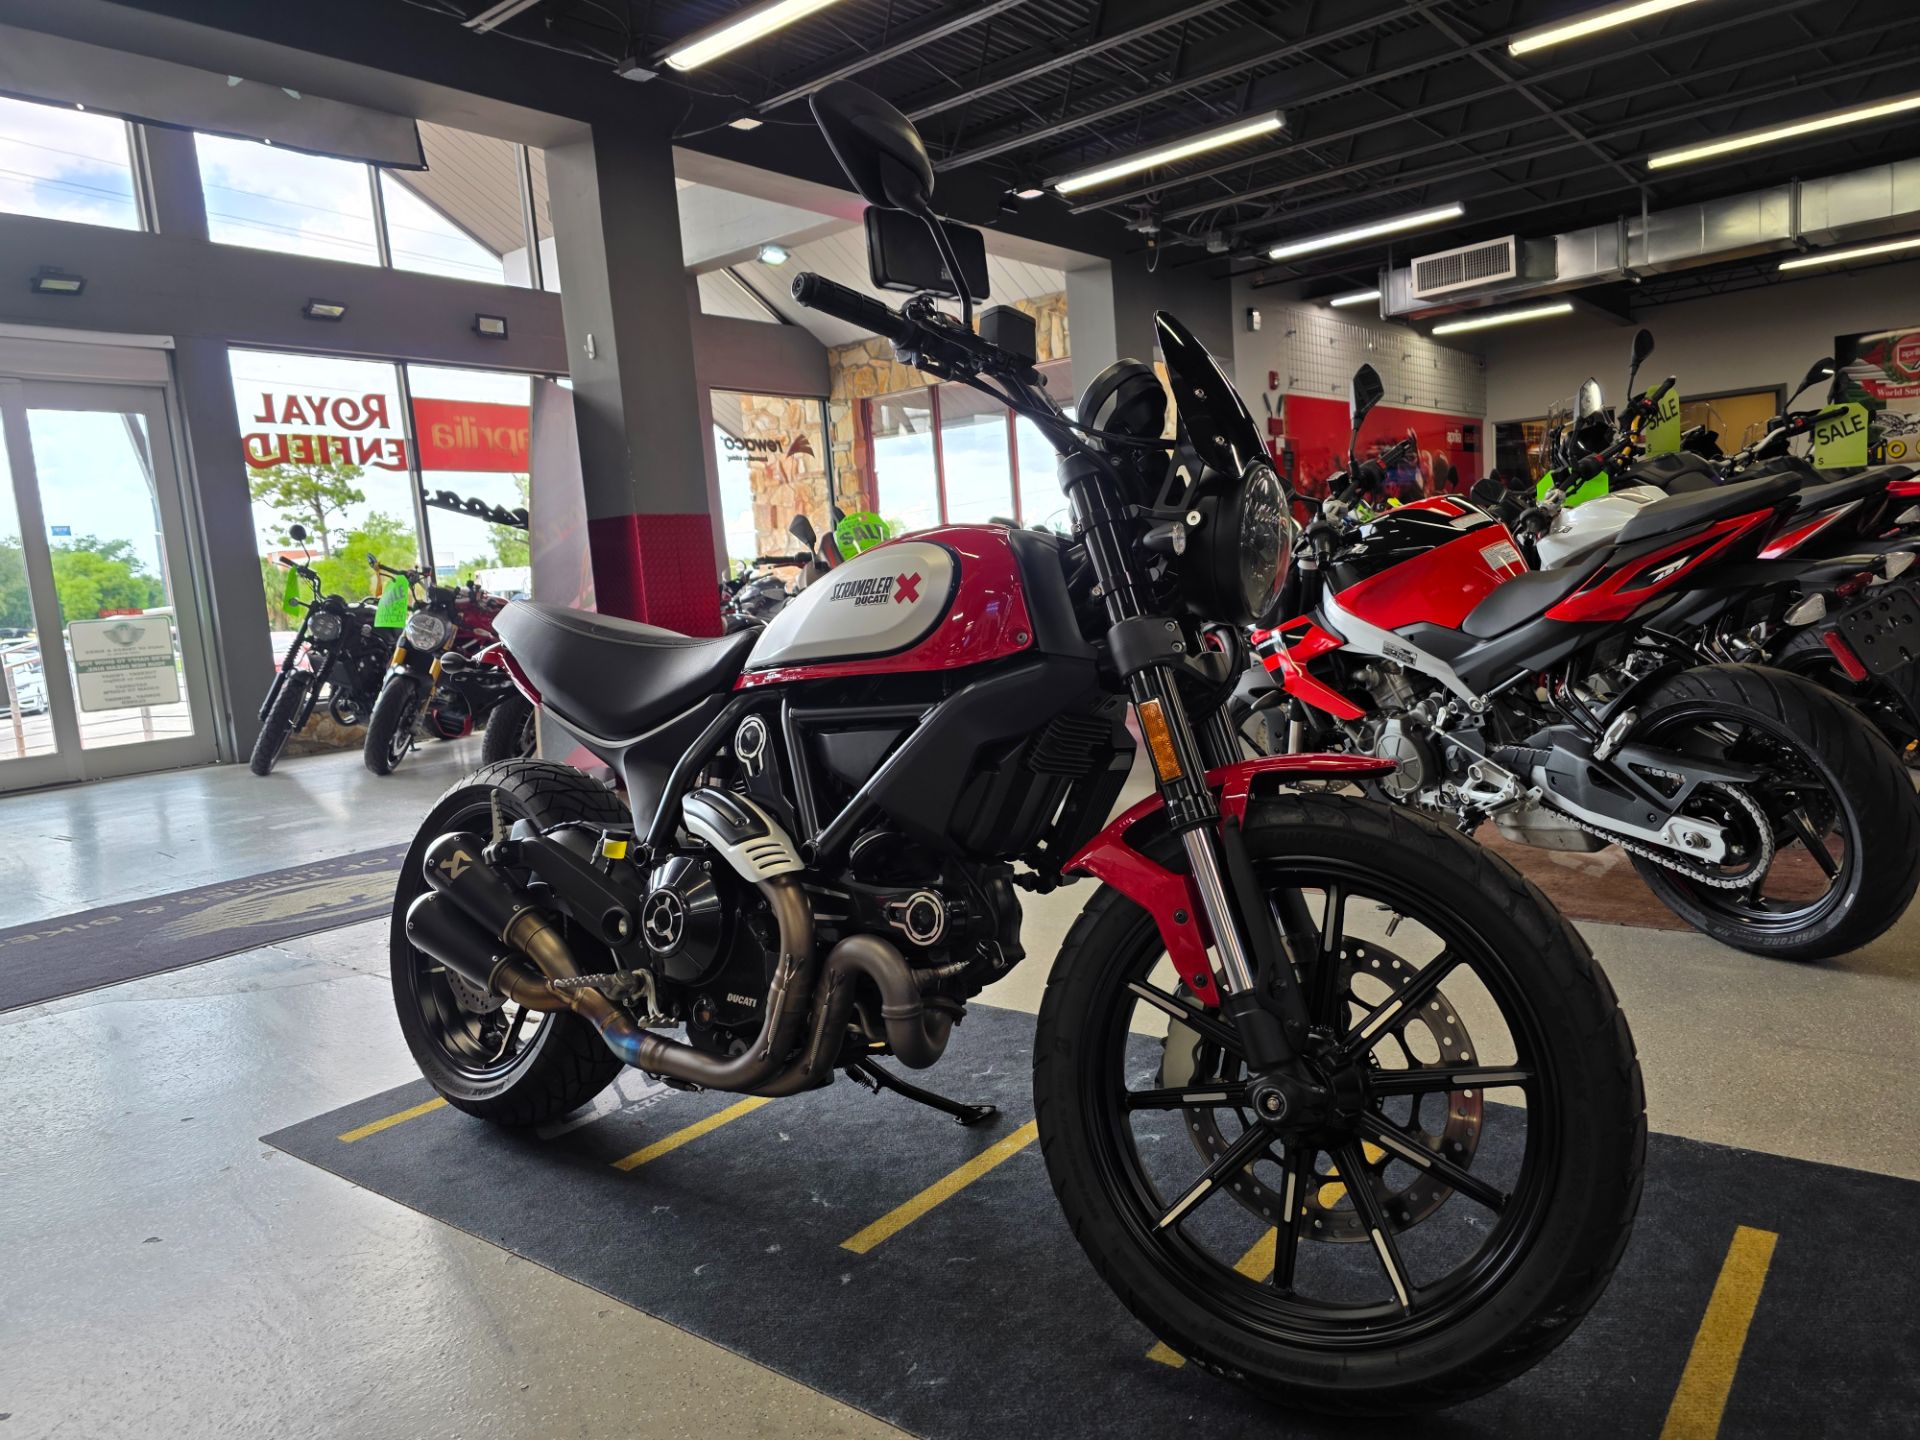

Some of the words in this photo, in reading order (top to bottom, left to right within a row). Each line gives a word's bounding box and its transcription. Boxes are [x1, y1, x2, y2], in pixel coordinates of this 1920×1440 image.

[1649, 398, 1679, 430] SALE
[1817, 414, 1866, 445] SALE
[830, 576, 894, 601] SCRAMBLER
[854, 593, 889, 607] DUCATI
[341, 857, 390, 872] OF
[727, 993, 757, 1008] DUCATI
